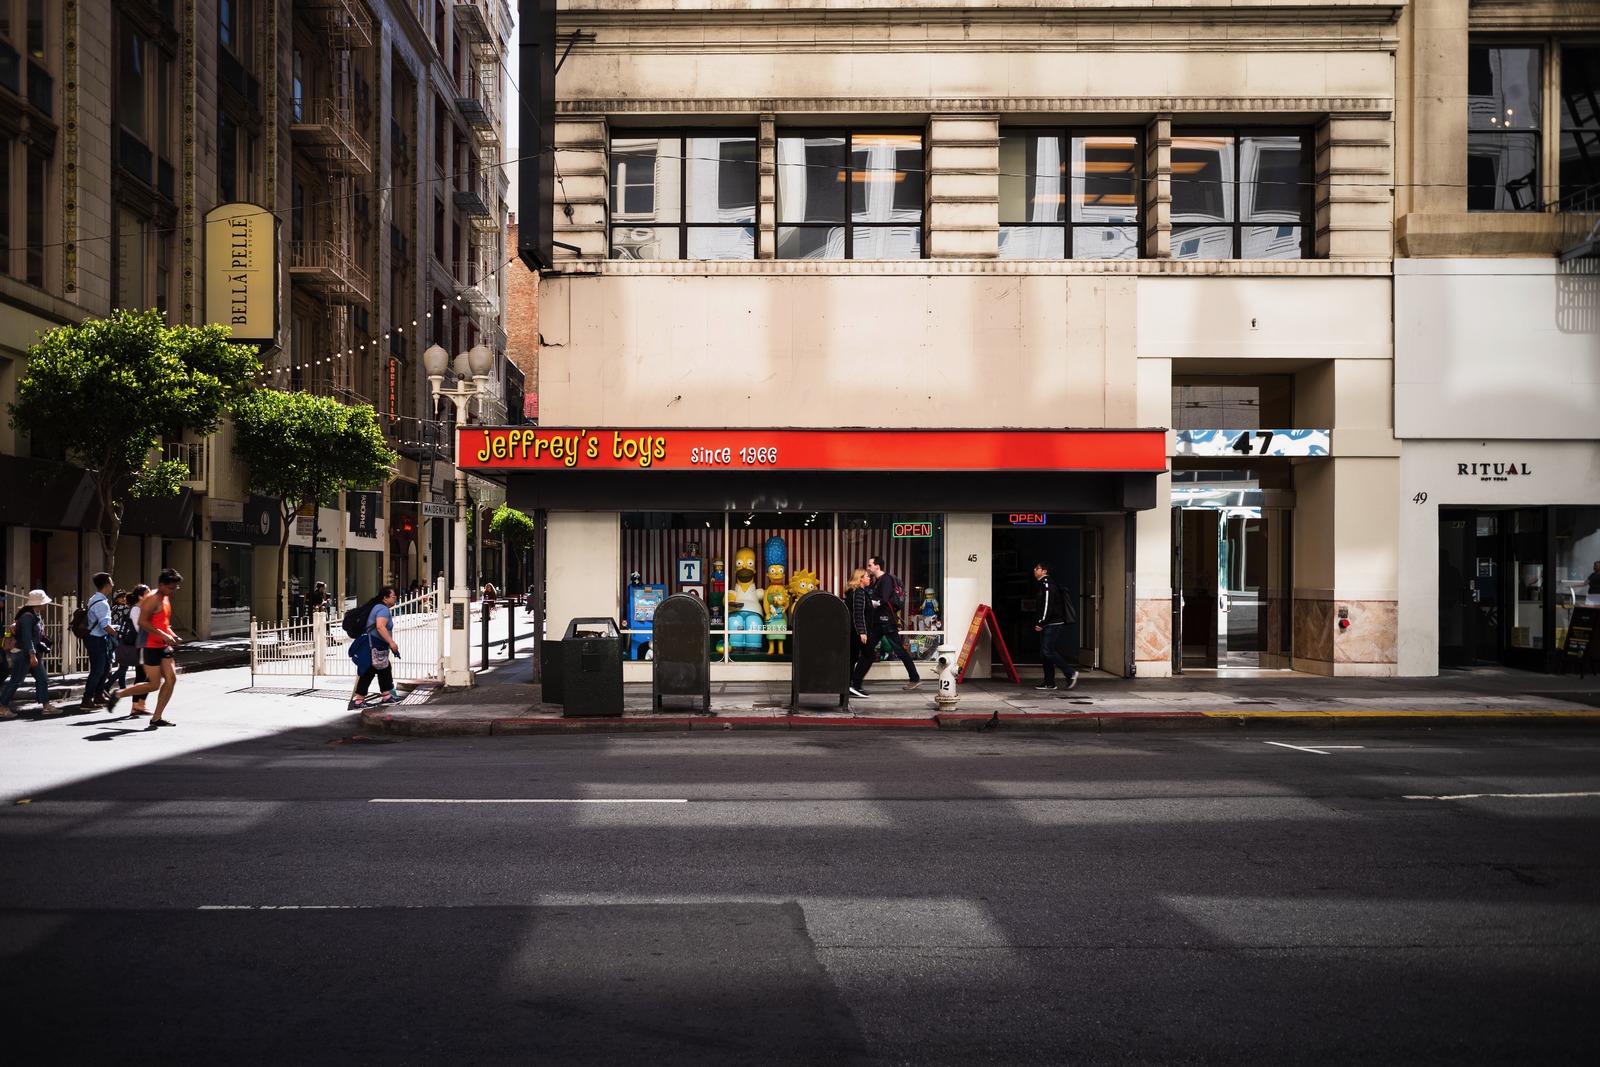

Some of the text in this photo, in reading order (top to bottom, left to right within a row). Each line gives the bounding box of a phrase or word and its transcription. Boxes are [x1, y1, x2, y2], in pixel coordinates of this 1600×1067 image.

[477, 429, 666, 467] jeffrey's toys
[1232, 431, 1274, 454] 47
[691, 447, 777, 464] since 1966
[1457, 463, 1531, 475] RITUAL
[1412, 491, 1428, 504] 49
[424, 504, 456, 516] MAIDEN LANE
[1009, 513, 1044, 523] OPEN
[894, 523, 931, 536] OPEN
[968, 554, 977, 562] 45
[684, 563, 695, 579] T
[940, 680, 949, 690] 12
